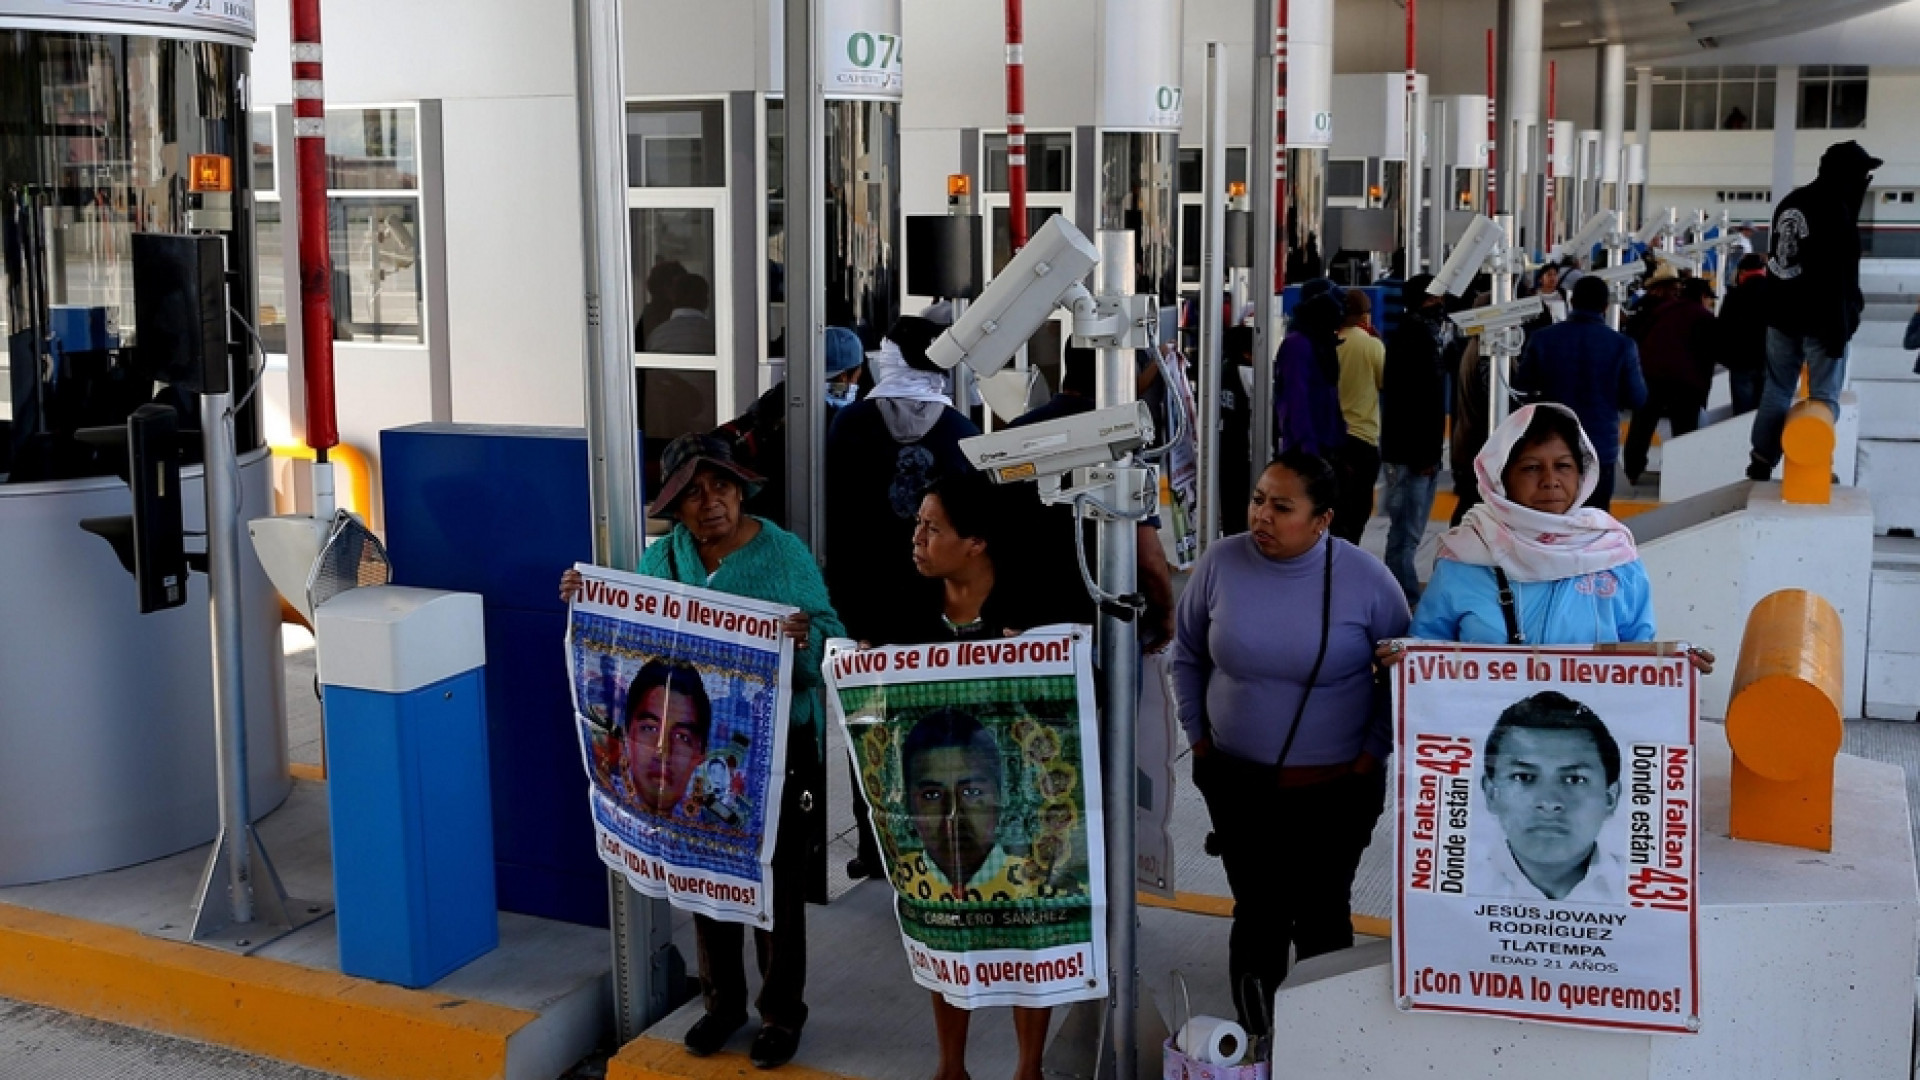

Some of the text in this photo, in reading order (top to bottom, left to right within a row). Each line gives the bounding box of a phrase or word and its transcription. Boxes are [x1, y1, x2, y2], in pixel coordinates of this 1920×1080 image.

[577, 579, 778, 640] ¡Vivo se lo llevaron!
[834, 637, 1070, 679] ¡Vivo se lo llevaron!
[1408, 654, 1684, 687] ¡Vivo se lo llevaron!
[1667, 748, 1688, 790] Nos
[1412, 775, 1437, 840] faltan
[1630, 745, 1657, 864] Dónde están
[1440, 777, 1469, 893] Dónde están
[1665, 798, 1688, 868] faltan
[668, 873, 755, 905] queremos!
[1411, 847, 1432, 889] Nos
[1474, 904, 1627, 926] JESÚS JOVANY
[1489, 921, 1613, 940] RODRÍGUEZ
[1490, 954, 1619, 973] EDAD 21 AÑOS
[1499, 938, 1606, 957] TLATEMPA
[953, 960, 970, 985] lo
[976, 952, 1084, 987] queremos!
[1414, 966, 1681, 1013] ¡Con VIDA lo queremos!
